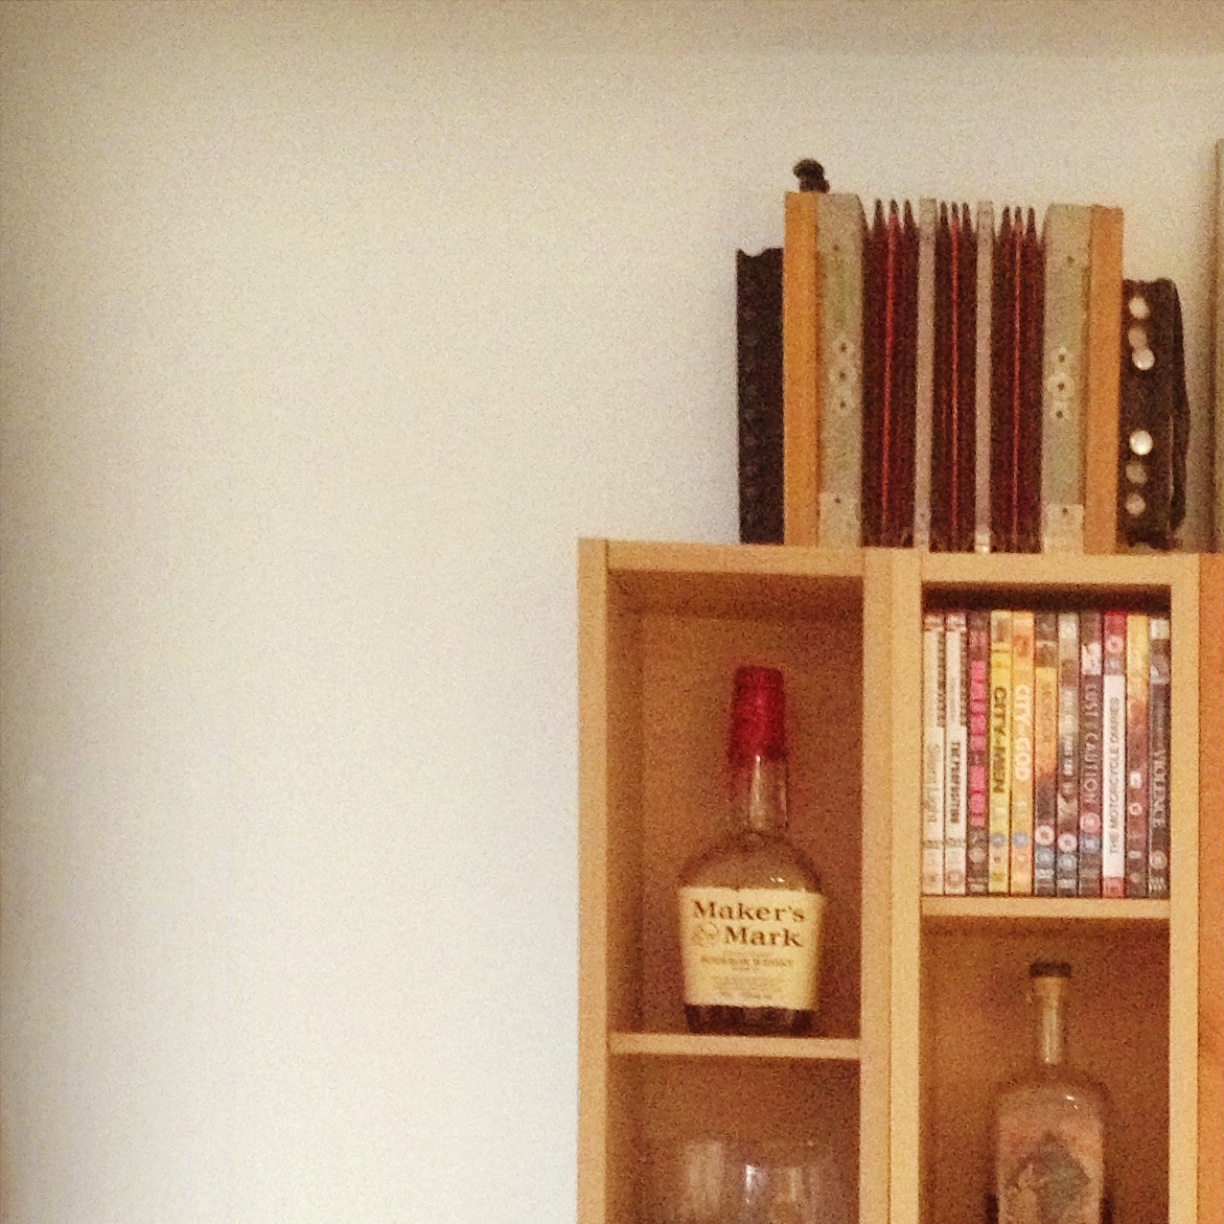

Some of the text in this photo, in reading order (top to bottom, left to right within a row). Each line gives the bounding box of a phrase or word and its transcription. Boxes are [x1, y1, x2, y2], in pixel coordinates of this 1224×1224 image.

[993, 687, 1008, 795] CITY MEN
[1014, 684, 1031, 783] CITY GOD
[1110, 697, 1121, 744] DIARIES
[1084, 732, 1099, 805] CAUTION
[1110, 746, 1121, 830] MOTORCYCLE
[1153, 749, 1166, 829] VIOLENCE
[692, 900, 806, 923] Maker's
[724, 925, 804, 948] Mark
